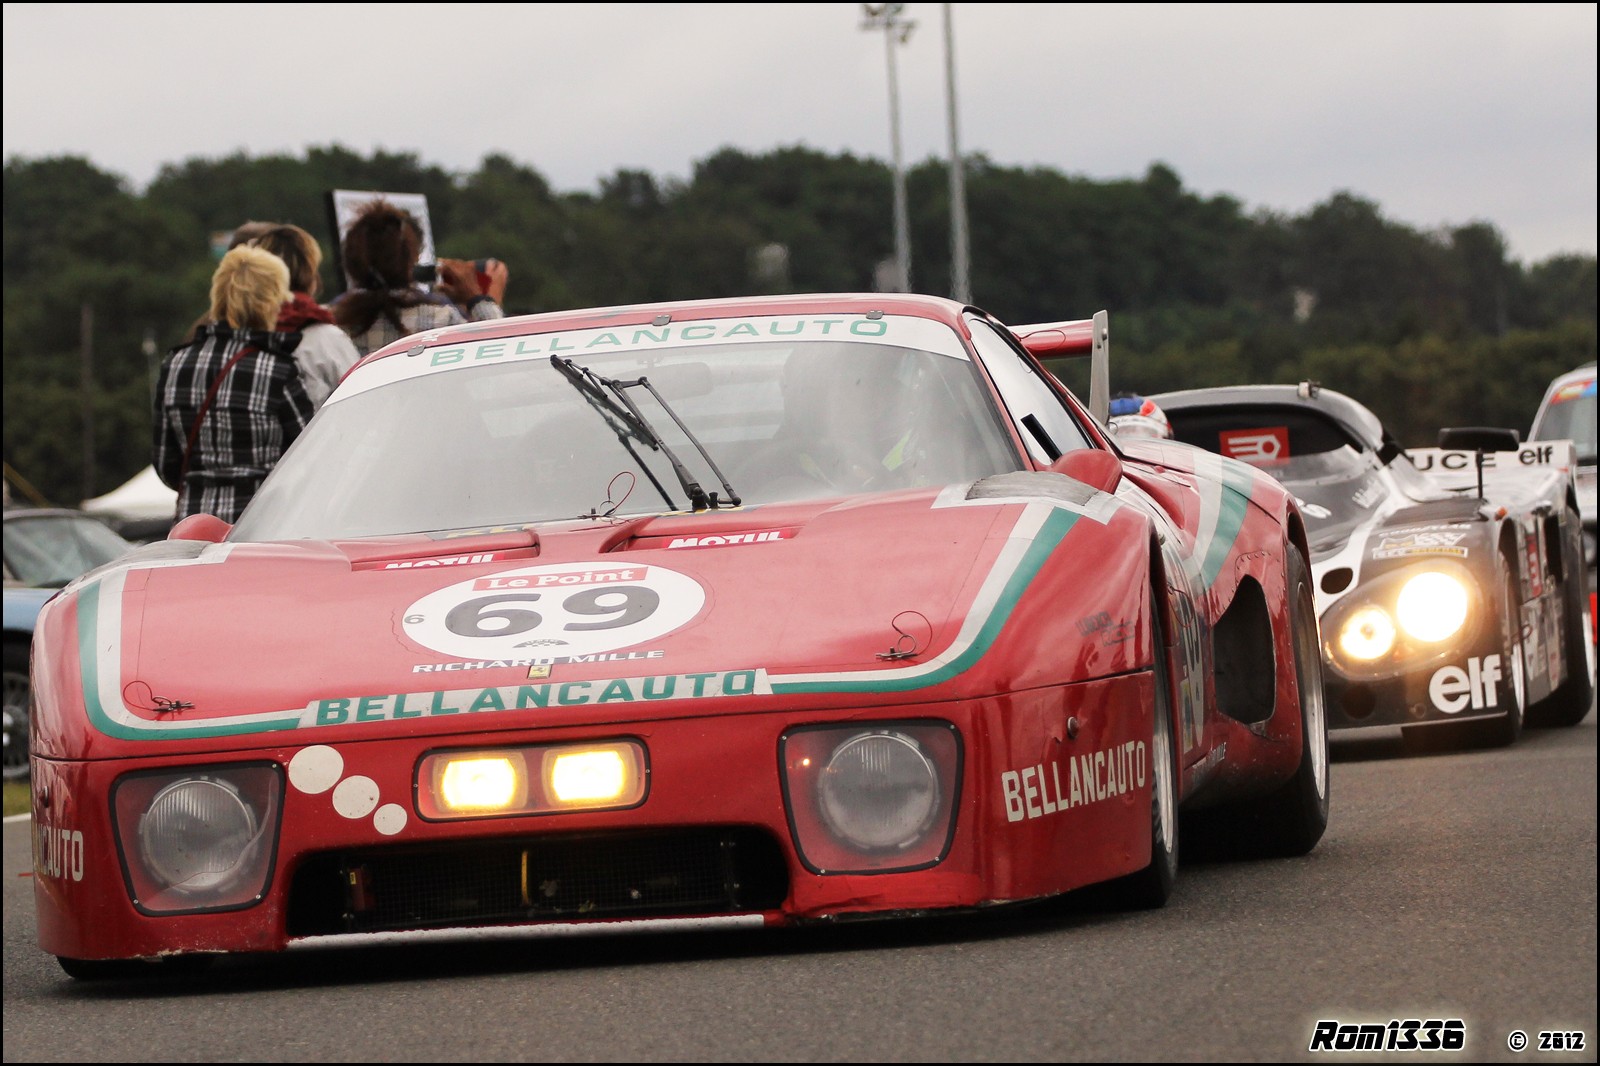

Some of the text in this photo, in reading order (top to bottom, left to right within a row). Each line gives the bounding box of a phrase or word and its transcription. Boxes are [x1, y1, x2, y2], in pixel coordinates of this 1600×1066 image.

[430, 319, 888, 367] BELLANCAUTO
[1518, 445, 1553, 466] elf
[668, 531, 784, 549] MOTUL
[487, 569, 635, 589] Le Point
[404, 614, 425, 625] 6
[445, 585, 660, 638] 69
[412, 649, 665, 674] RICHARD MILLE
[316, 670, 756, 726] BELLANCAUTO
[1428, 653, 1502, 714] elf
[1001, 740, 1146, 823] BELLANCAUTO
